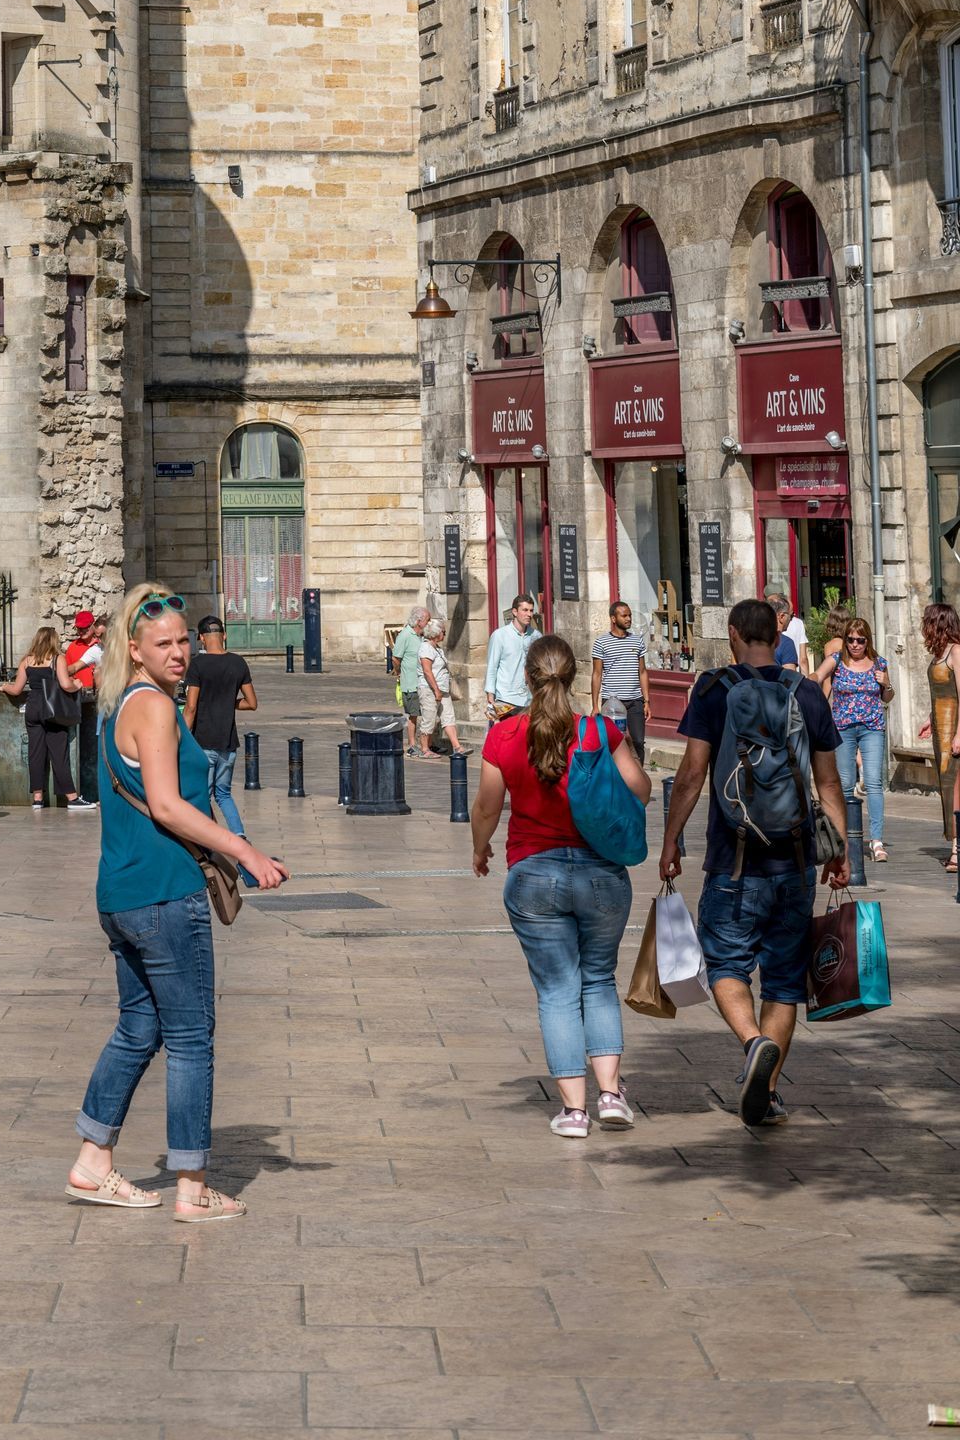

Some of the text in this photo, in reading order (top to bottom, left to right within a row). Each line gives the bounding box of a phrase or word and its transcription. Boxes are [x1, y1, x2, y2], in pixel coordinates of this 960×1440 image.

[789, 373, 800, 382] Cave
[766, 387, 826, 418] ART & VINS
[614, 397, 665, 425] ART & VINS
[492, 409, 533, 433] ART & VINS
[786, 423, 792, 432] du
[792, 422, 815, 431] savoir-boire
[779, 461, 786, 472] Le
[822, 460, 840, 473] whisky
[263, 493, 301, 505] D'ANTAN
